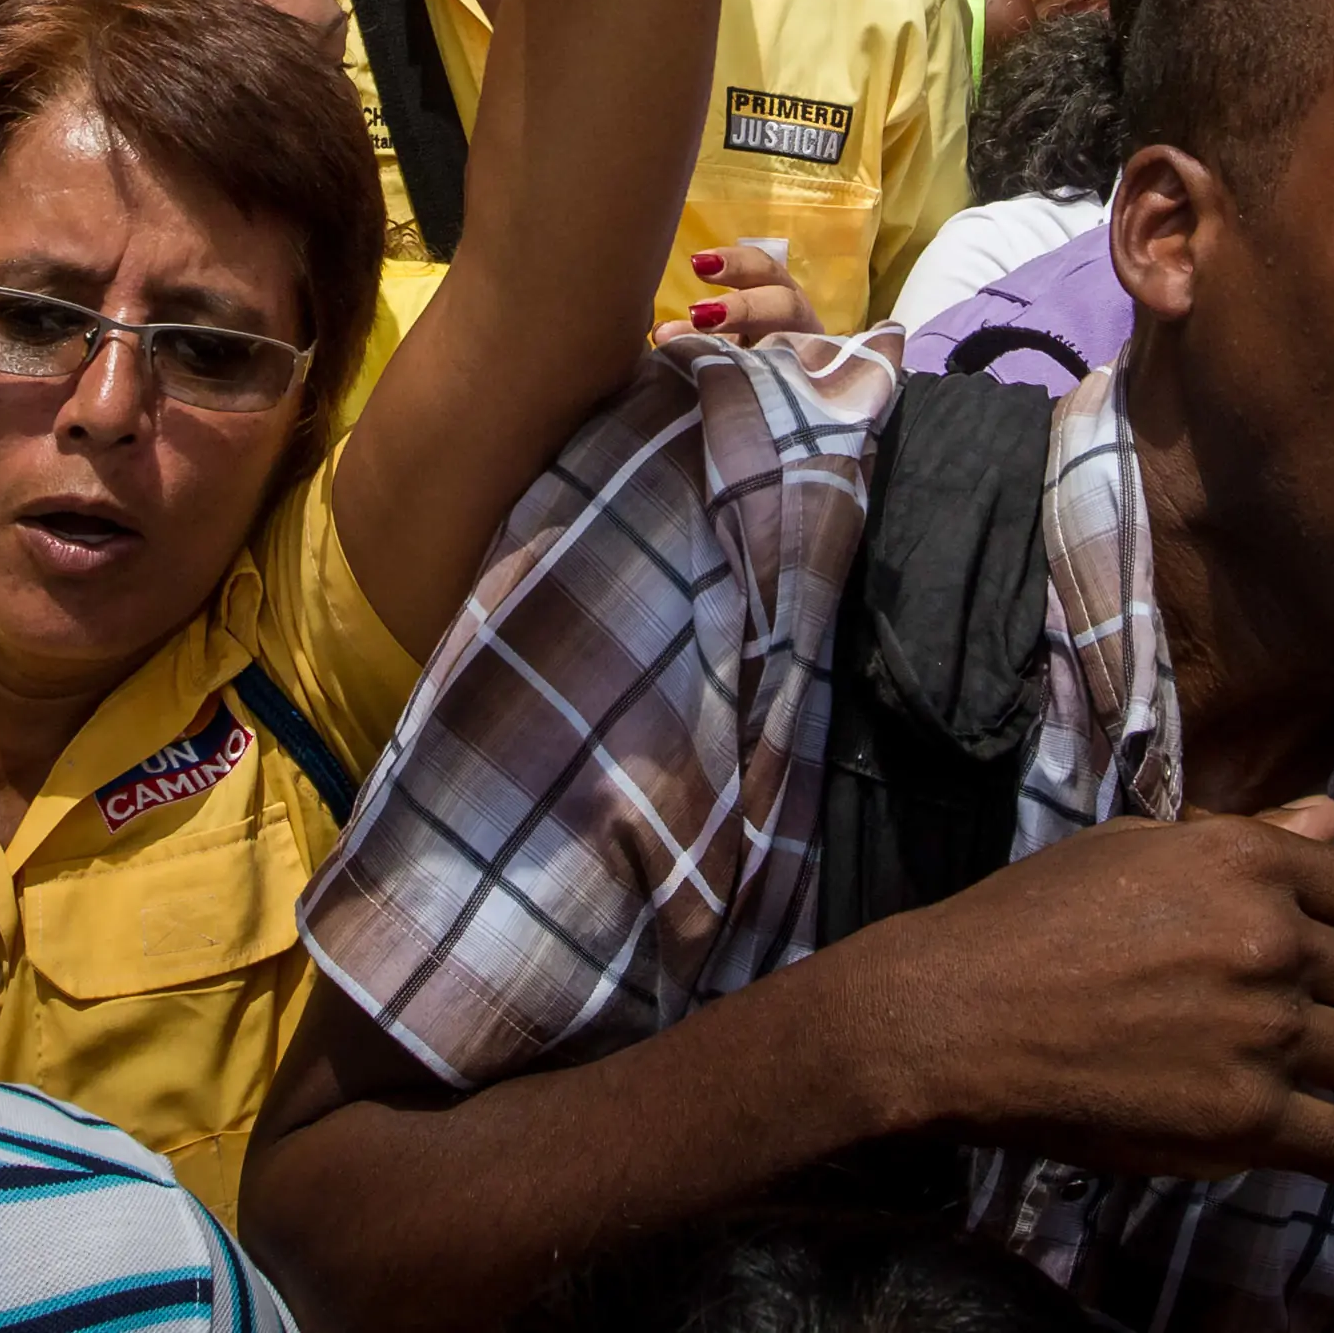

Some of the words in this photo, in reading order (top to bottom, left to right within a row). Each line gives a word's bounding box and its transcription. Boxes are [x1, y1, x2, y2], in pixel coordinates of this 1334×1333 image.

[734, 92, 846, 130] PRIMERO
[731, 114, 840, 159] JUSTICIA
[104, 726, 250, 824] CAMINO
[140, 735, 197, 777] UN
